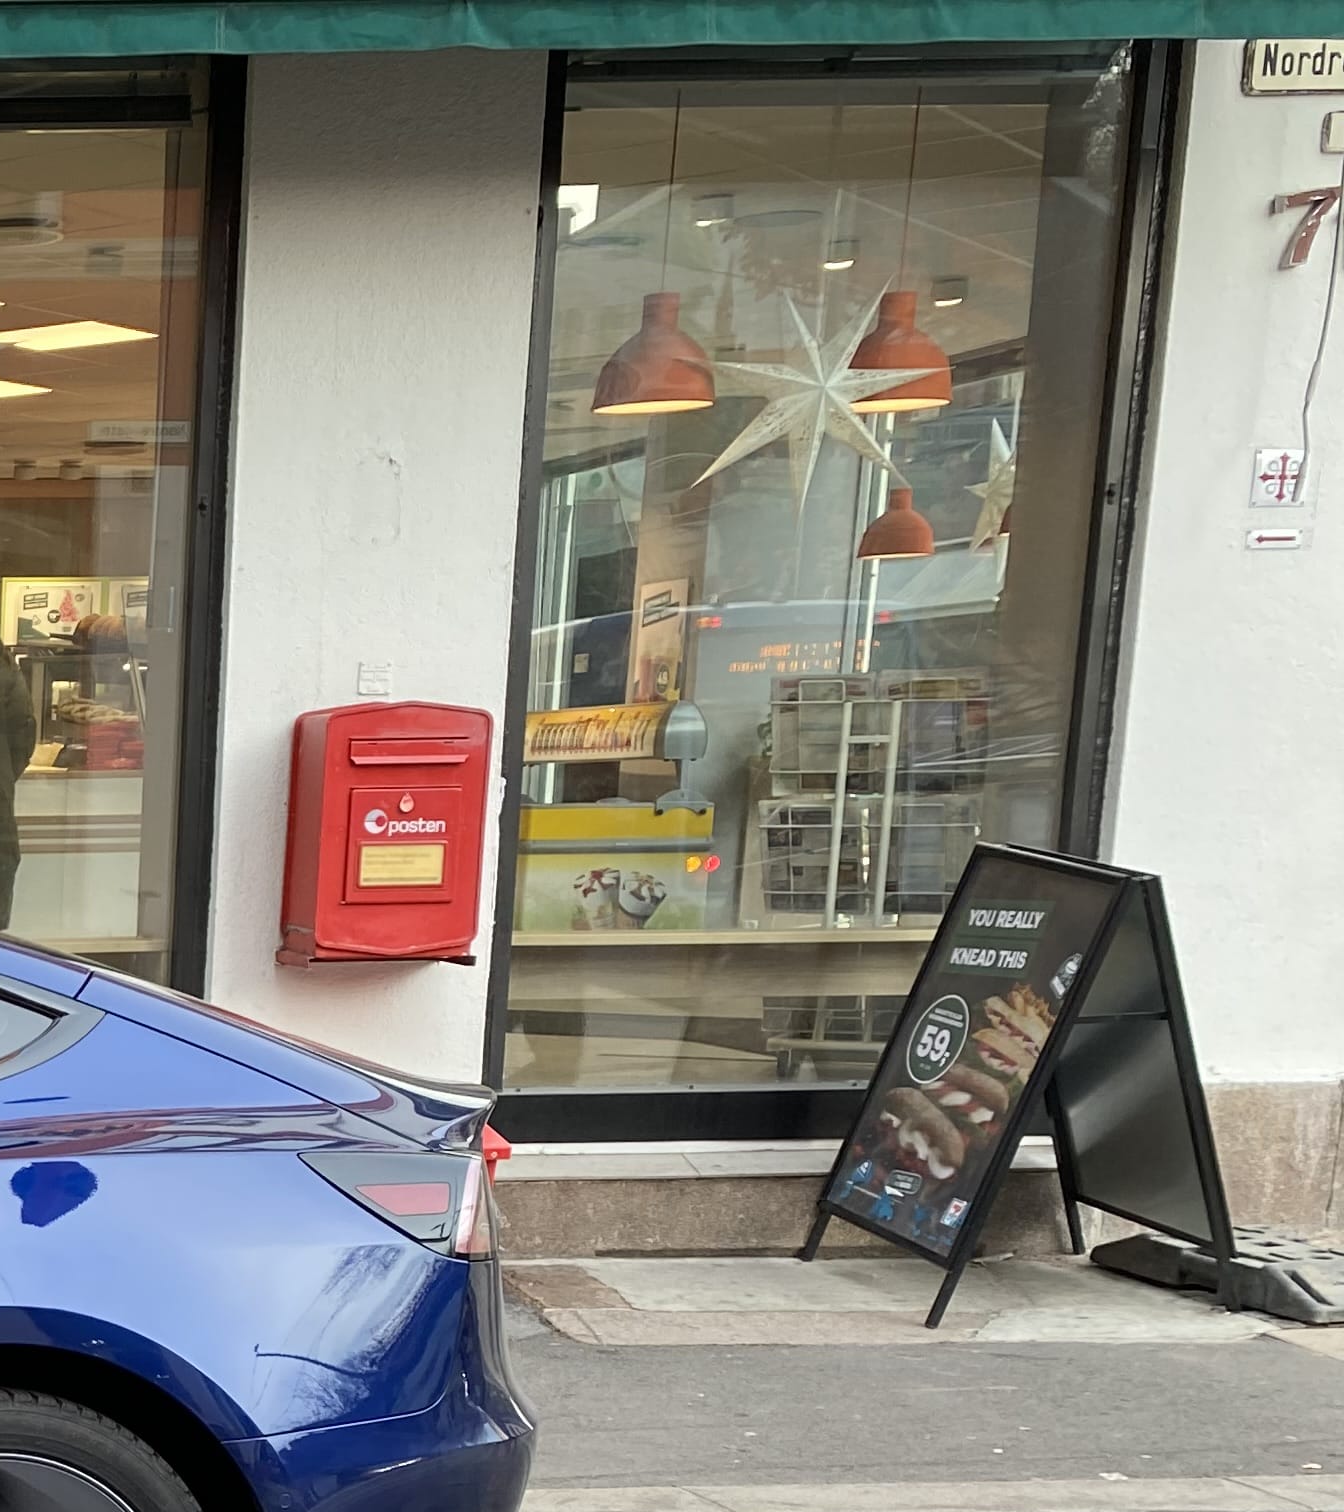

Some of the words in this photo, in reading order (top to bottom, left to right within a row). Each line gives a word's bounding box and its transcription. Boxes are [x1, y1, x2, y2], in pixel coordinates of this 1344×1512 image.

[1262, 43, 1344, 76] Nordr
[1269, 186, 1342, 271] 7
[387, 817, 446, 837] posten
[968, 909, 996, 928] YOU
[995, 910, 1045, 929] REALLY
[950, 947, 997, 967] KNEAD
[996, 950, 1028, 969] THIS
